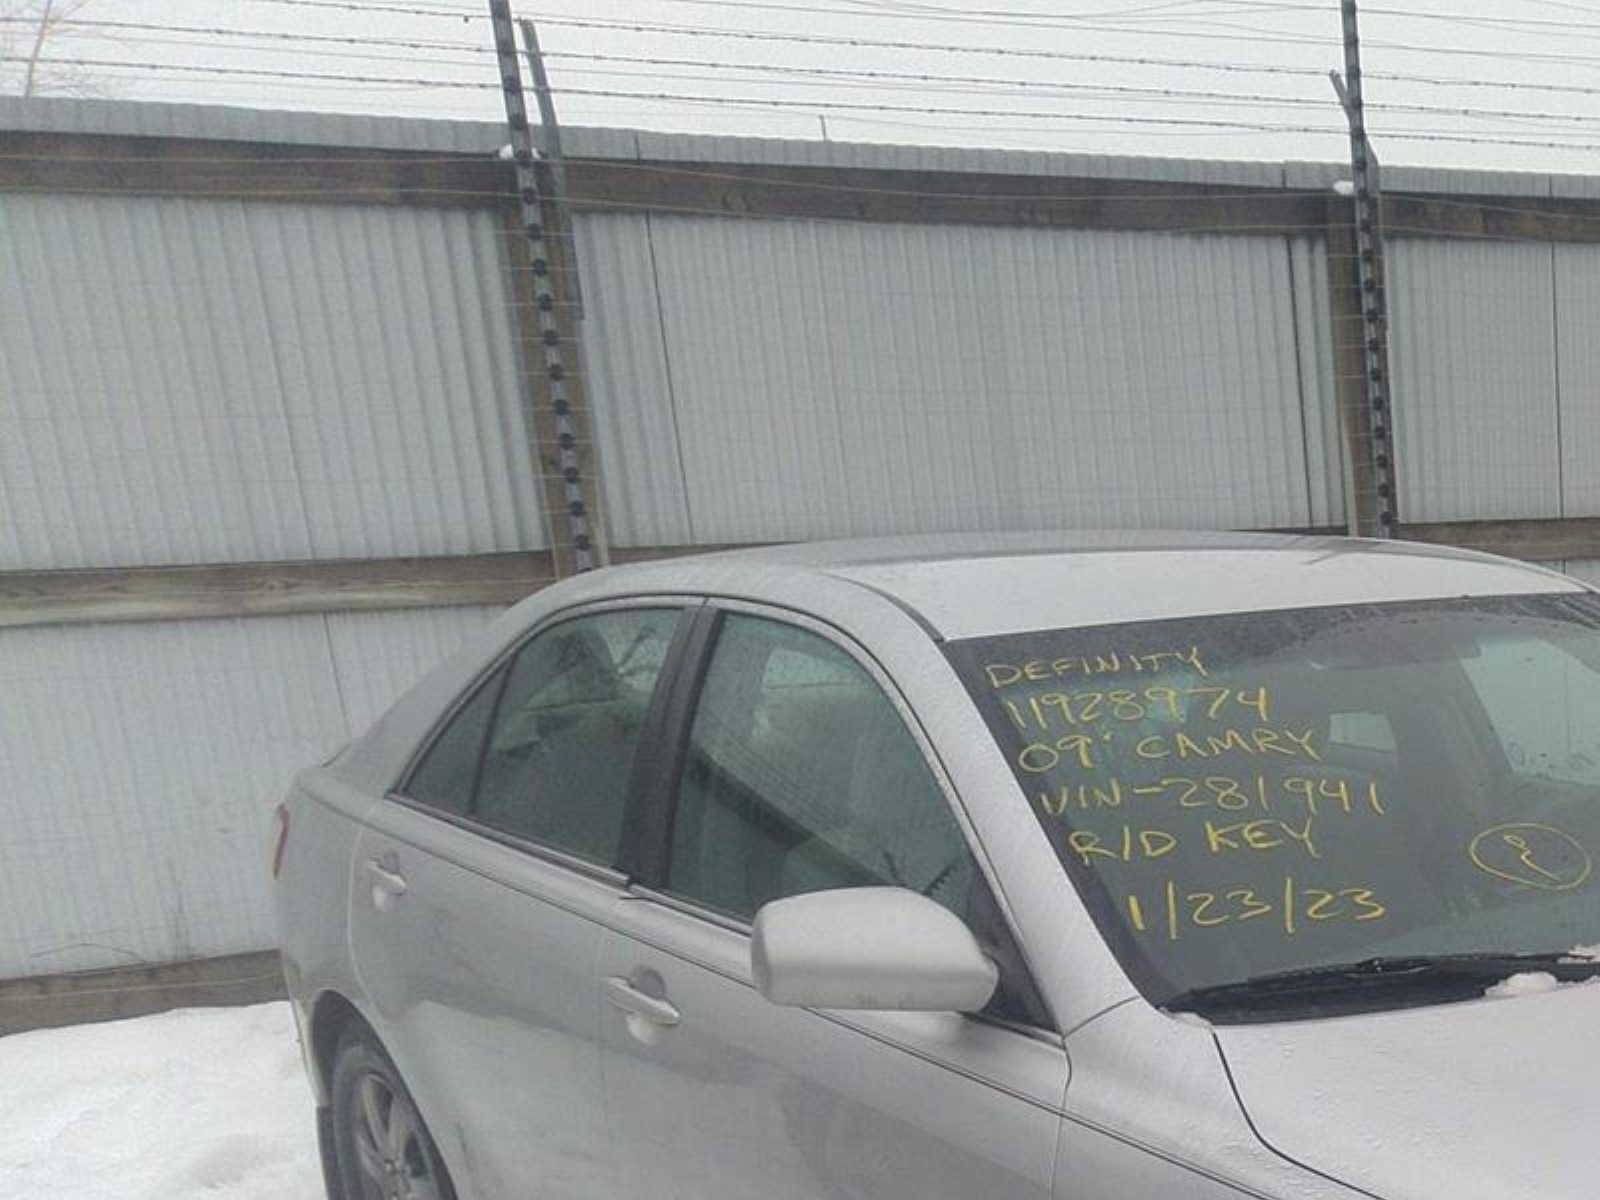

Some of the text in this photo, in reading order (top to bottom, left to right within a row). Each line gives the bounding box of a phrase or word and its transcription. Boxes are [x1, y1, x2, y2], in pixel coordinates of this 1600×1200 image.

[984, 646, 1209, 689] DEFINITY
[1006, 687, 1270, 731] 11928974
[1135, 727, 1322, 761] CAMRY
[1205, 818, 1322, 859] KEY
[1127, 876, 1387, 941] 1/23/23
